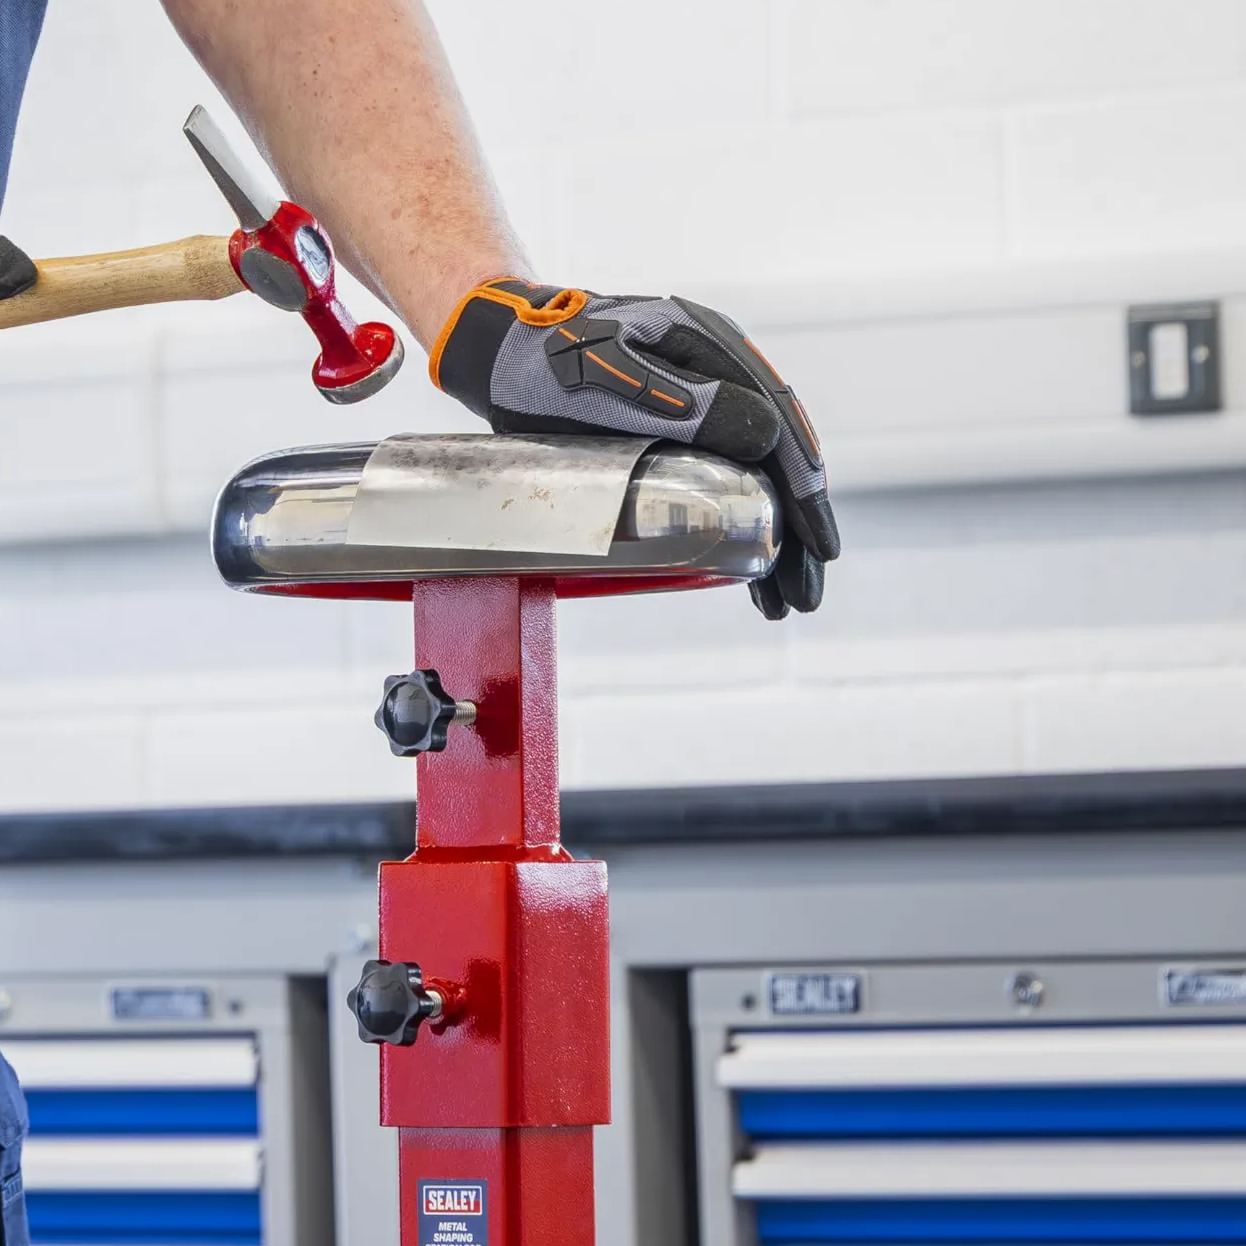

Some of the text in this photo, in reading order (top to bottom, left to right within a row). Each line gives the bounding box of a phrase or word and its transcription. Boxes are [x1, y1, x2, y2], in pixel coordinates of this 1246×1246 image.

[428, 1190, 476, 1211] SEALEY
[438, 1221, 468, 1232] METAL
[433, 1232, 474, 1243] SHAPING
